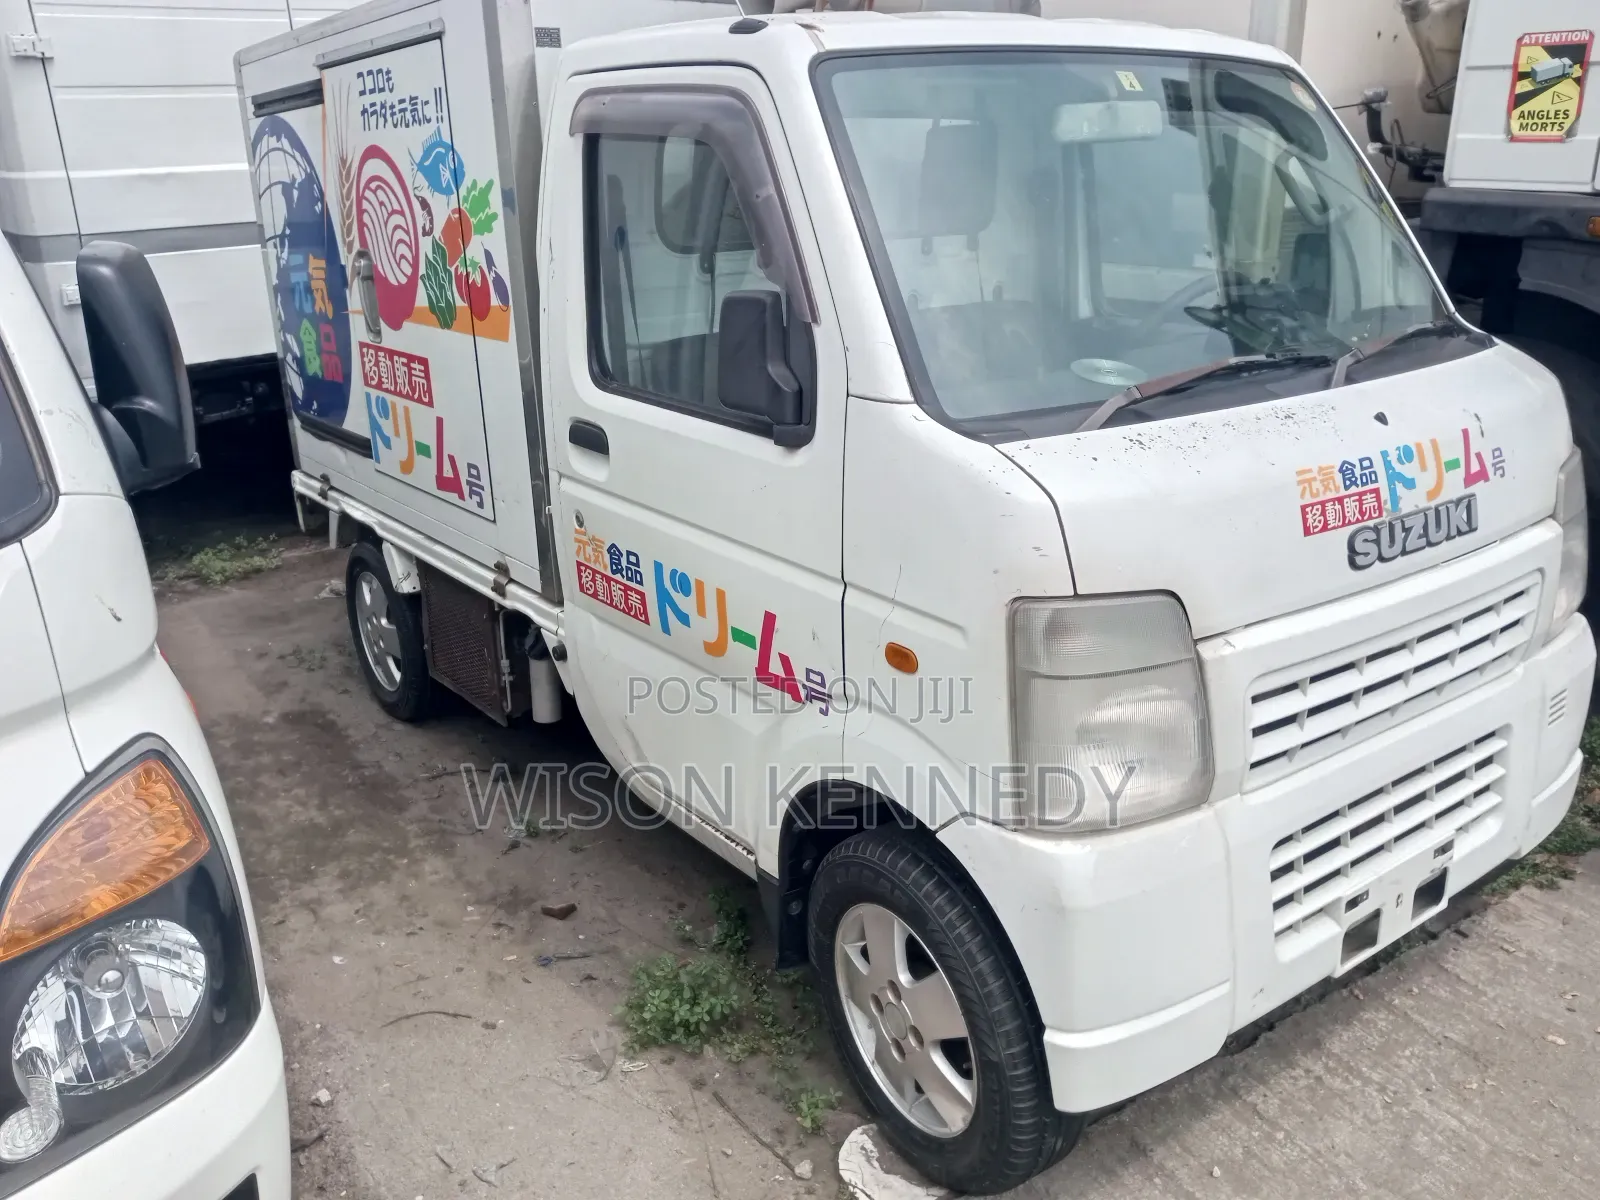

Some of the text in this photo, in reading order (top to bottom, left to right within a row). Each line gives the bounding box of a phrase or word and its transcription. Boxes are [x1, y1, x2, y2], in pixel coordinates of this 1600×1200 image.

[1522, 30, 1590, 44] ATTENTION
[356, 67, 395, 97] ココロも
[1517, 109, 1570, 121] ANGLES
[1518, 121, 1566, 132] MORTS
[288, 253, 333, 320] 元気
[300, 318, 344, 383] 食品
[362, 347, 429, 403] 移動販売
[365, 391, 485, 510] ドリーム号
[1295, 456, 1379, 500] 元気食品
[1379, 427, 1506, 513] ドリーム号
[1305, 491, 1380, 535] 移動販売
[1347, 492, 1478, 572] SUZUKI
[573, 527, 644, 587] 元気食品
[580, 565, 645, 621] 移動販売
[653, 559, 833, 717] ドリーム号
